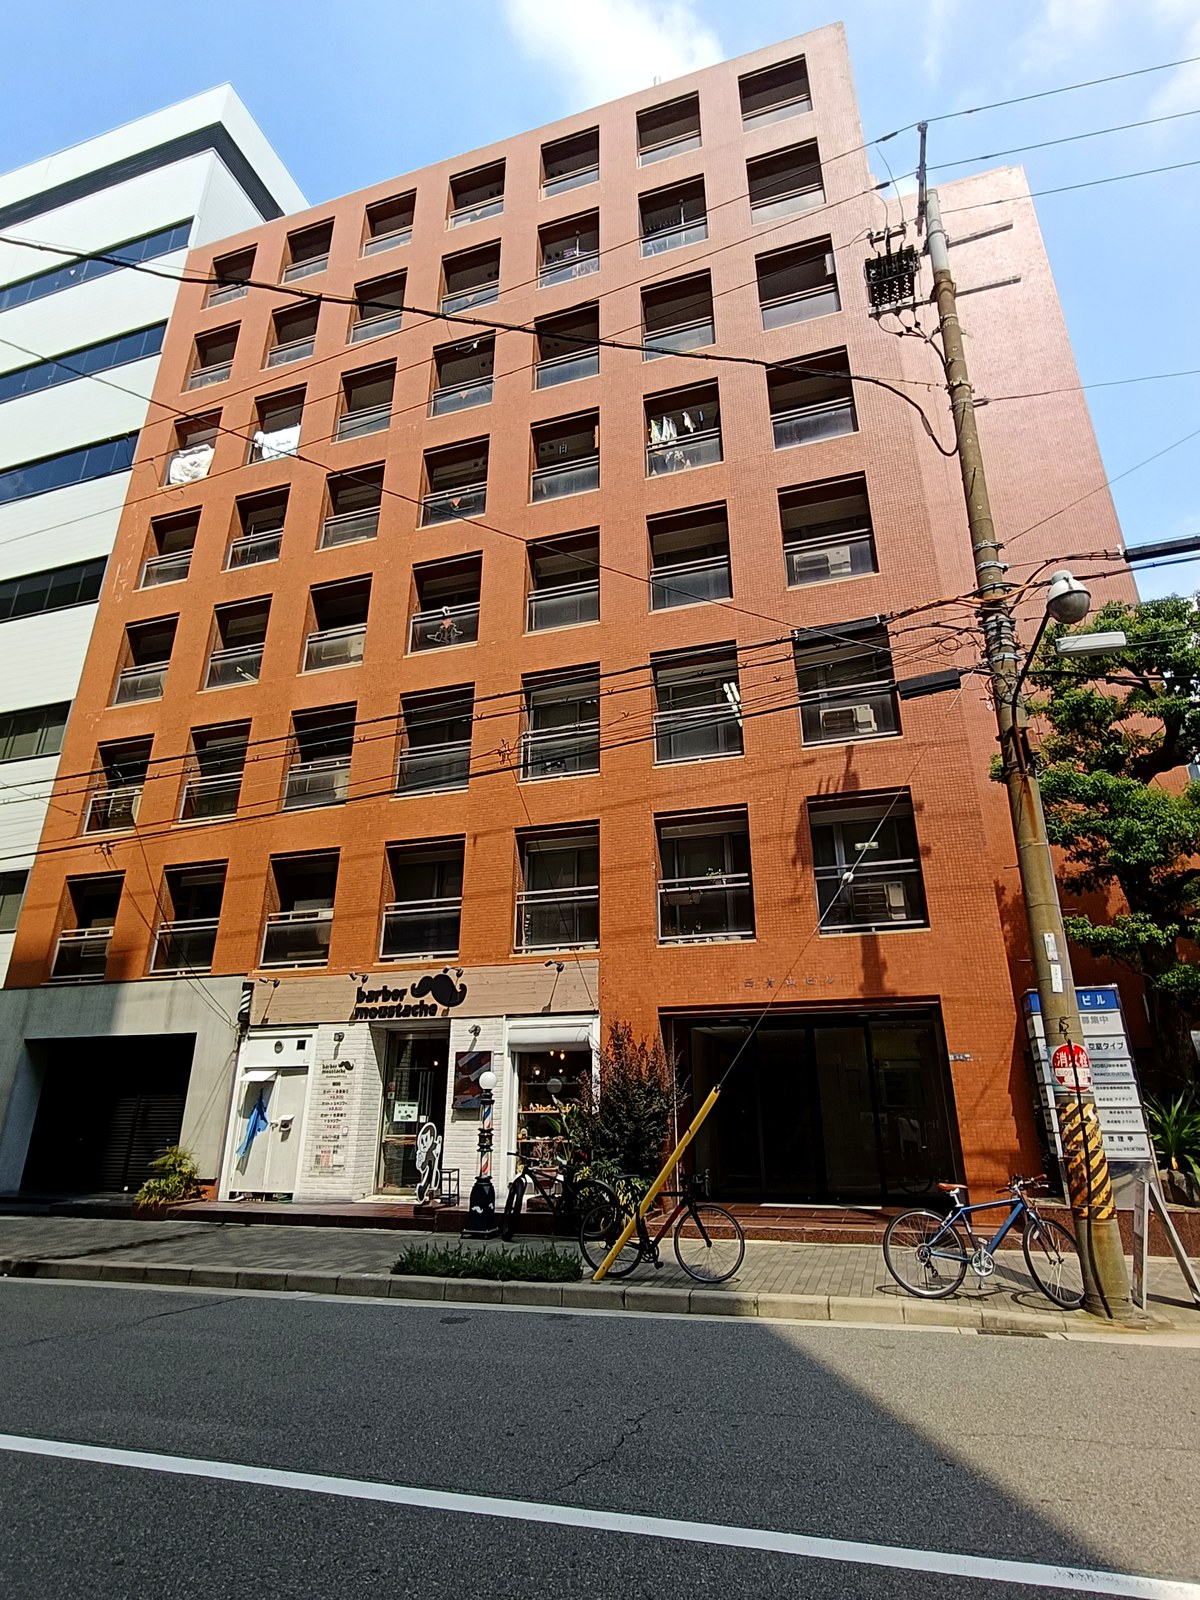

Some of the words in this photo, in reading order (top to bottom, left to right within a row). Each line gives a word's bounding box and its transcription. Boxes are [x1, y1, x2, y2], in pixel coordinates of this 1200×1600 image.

[356, 985, 408, 1004] barber
[1081, 994, 1106, 1006] ビル
[355, 999, 438, 1019] moustache
[1054, 1051, 1089, 1067] 消火栓
